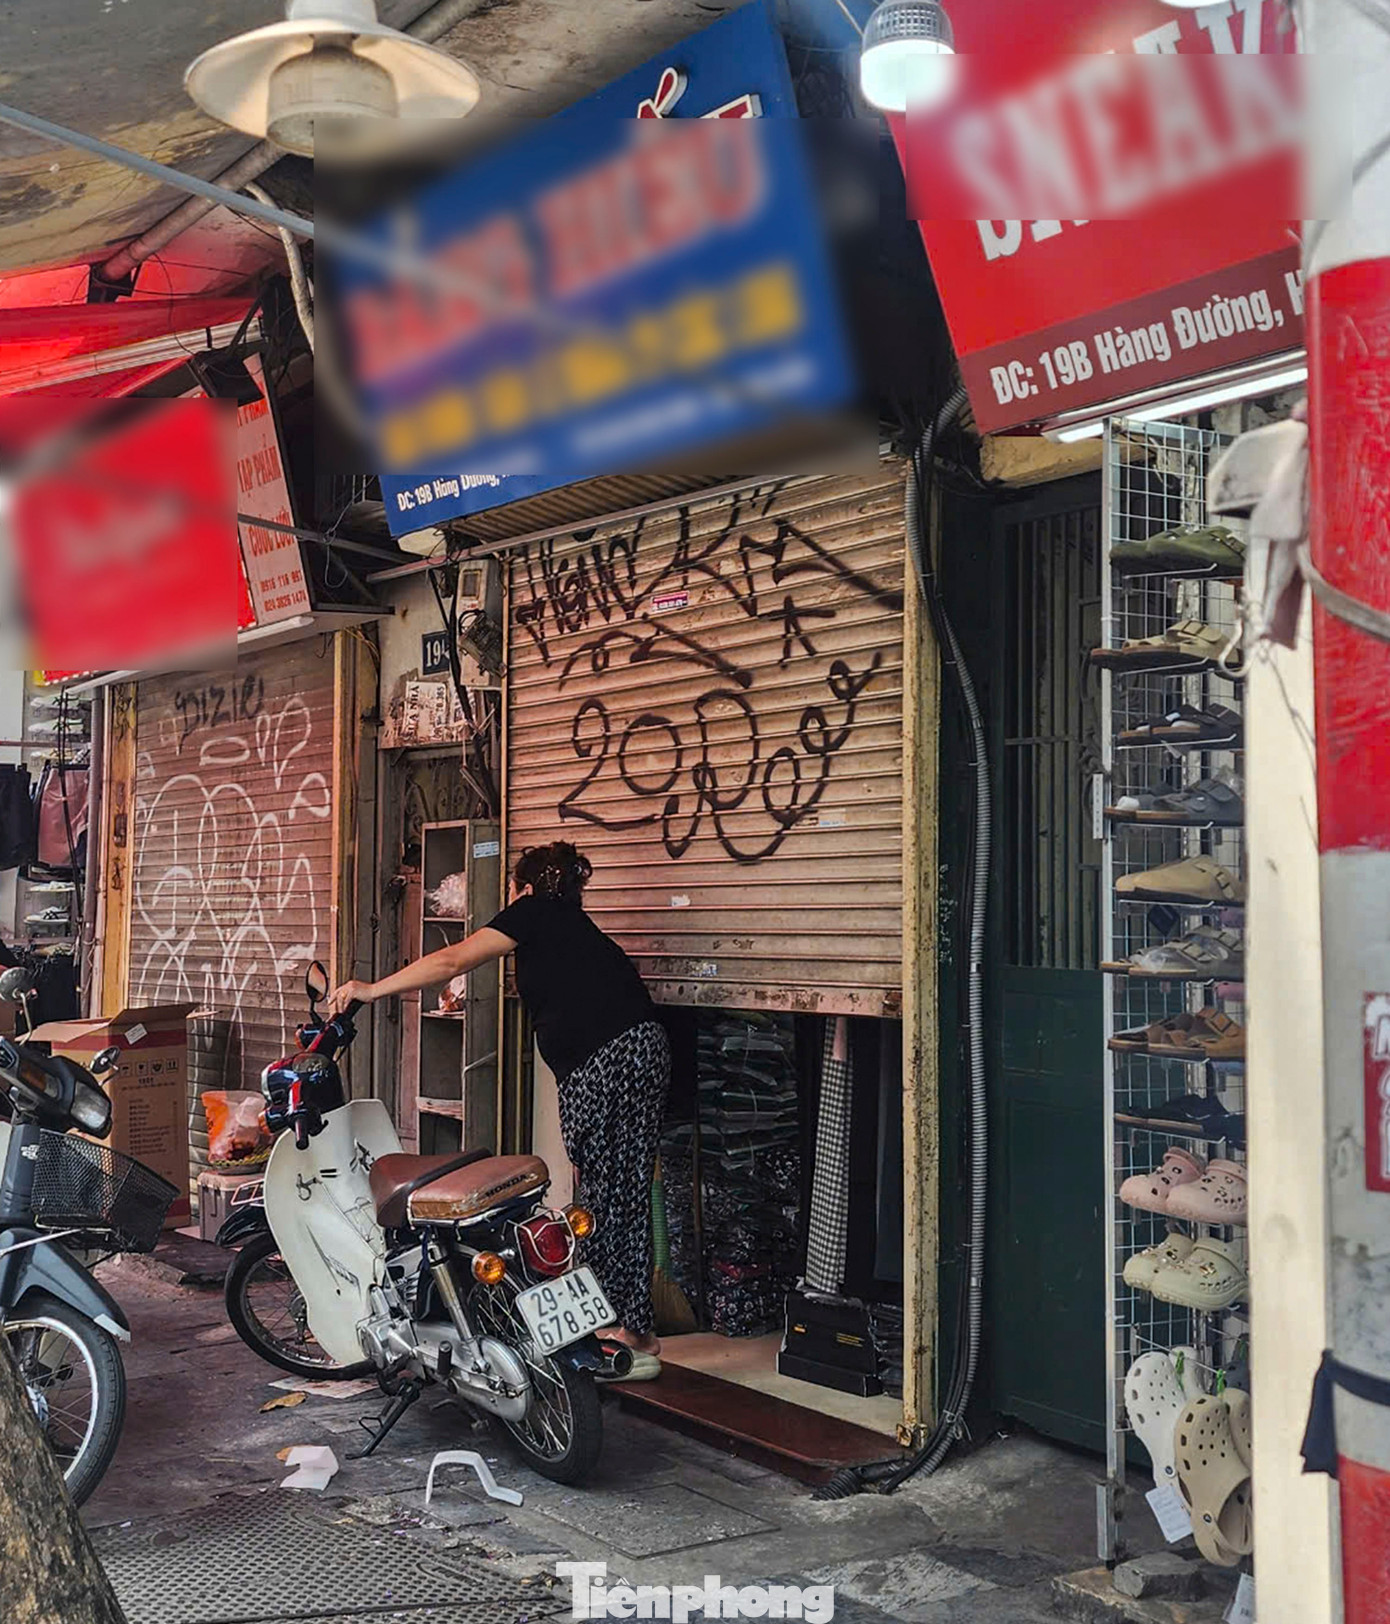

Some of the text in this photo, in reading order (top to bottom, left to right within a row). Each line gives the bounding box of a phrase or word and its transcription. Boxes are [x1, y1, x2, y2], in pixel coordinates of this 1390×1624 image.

[1039, 340, 1094, 389] 19B
[1094, 326, 1172, 374] Hàng
[1171, 289, 1284, 350] Đường,
[414, 484, 433, 505] 19B
[530, 1273, 590, 1318] 29-AA
[537, 1296, 609, 1347] 678.58
